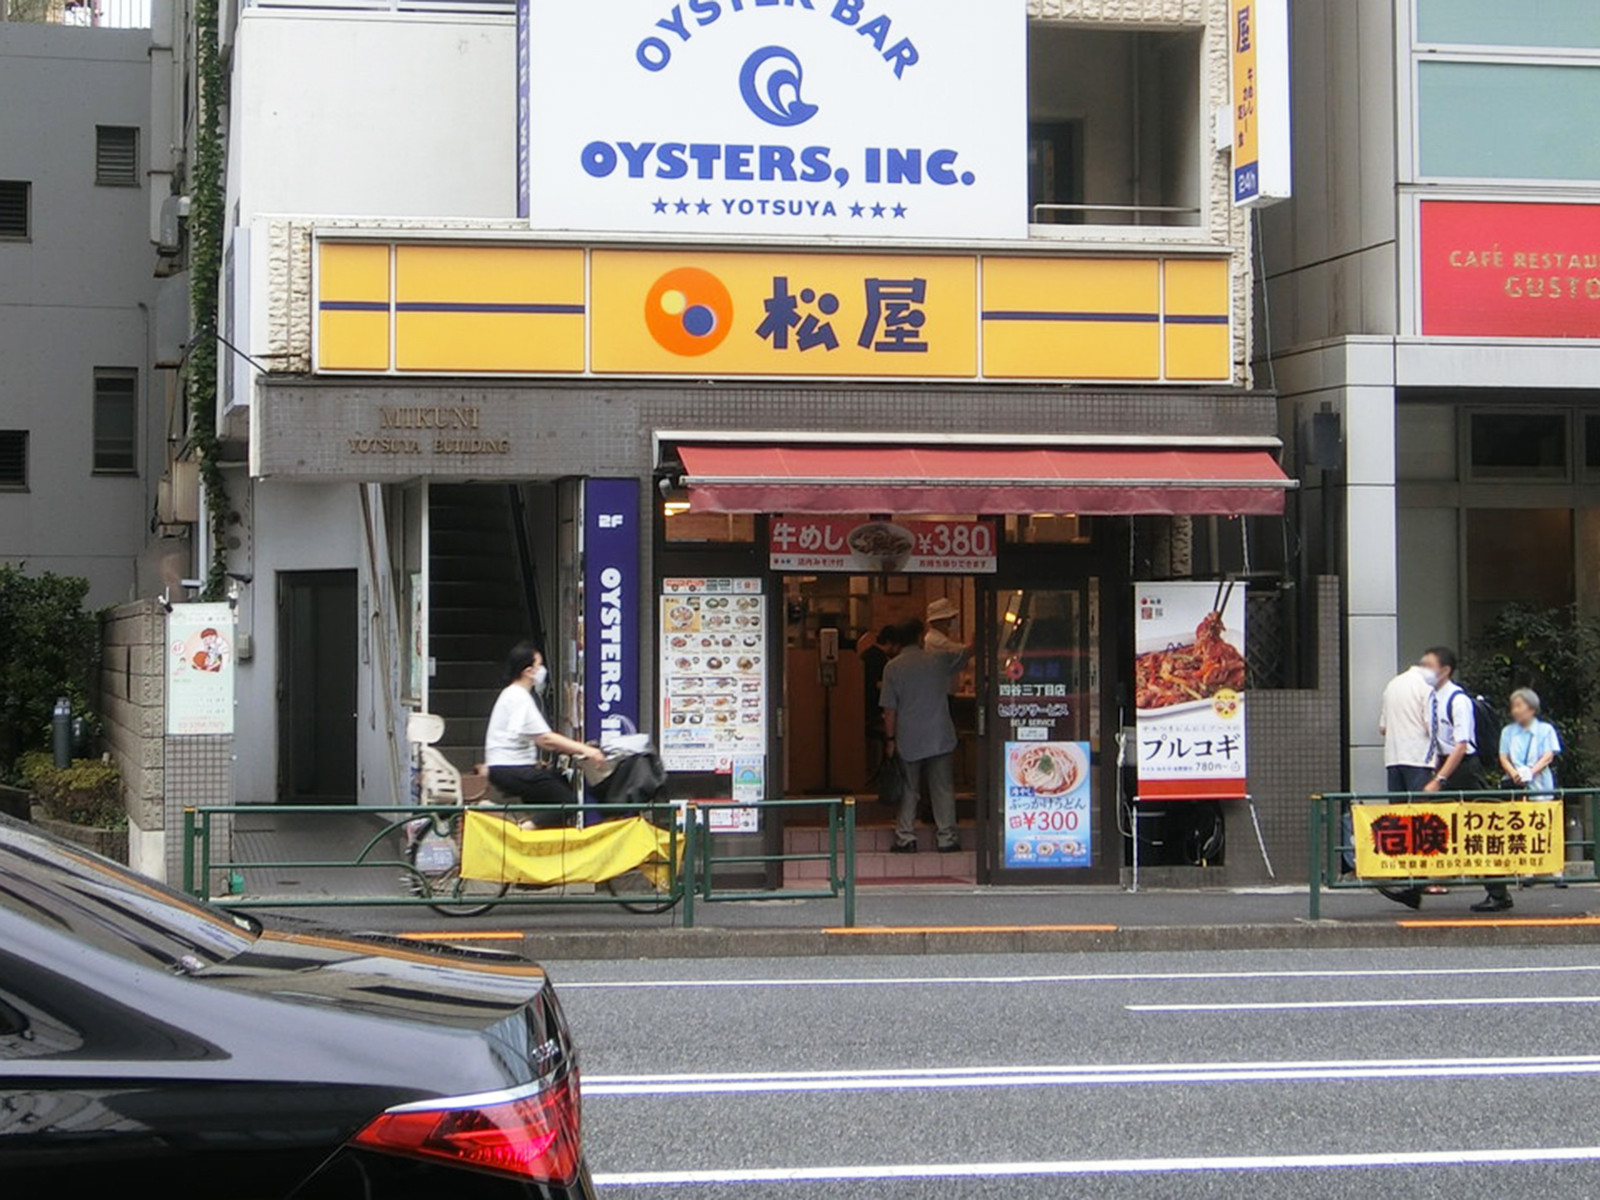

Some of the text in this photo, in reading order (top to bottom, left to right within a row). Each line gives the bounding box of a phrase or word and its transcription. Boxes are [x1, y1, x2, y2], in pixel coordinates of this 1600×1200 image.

[830, 0, 920, 80] BAR
[580, 140, 849, 189] OYSTERS,
[865, 147, 976, 186] INC.
[722, 198, 837, 217] YOTSUYA
[1449, 243, 1503, 268] CAFÉ
[1504, 275, 1600, 299] GUSTO
[755, 276, 929, 353] 松屋
[379, 405, 480, 430] MIKUNI
[347, 436, 511, 455] YOTSUYA BUILDING
[772, 522, 991, 556] 牛めし ¥380
[597, 566, 622, 713] OYSTERS,
[999, 684, 1066, 696] 四谷三丁目店
[1142, 733, 1242, 761] プルコギ
[1023, 810, 1079, 832] ¥300
[1369, 808, 1554, 856] 危険! わたるな!
[1463, 832, 1553, 856] 横断禁止!
